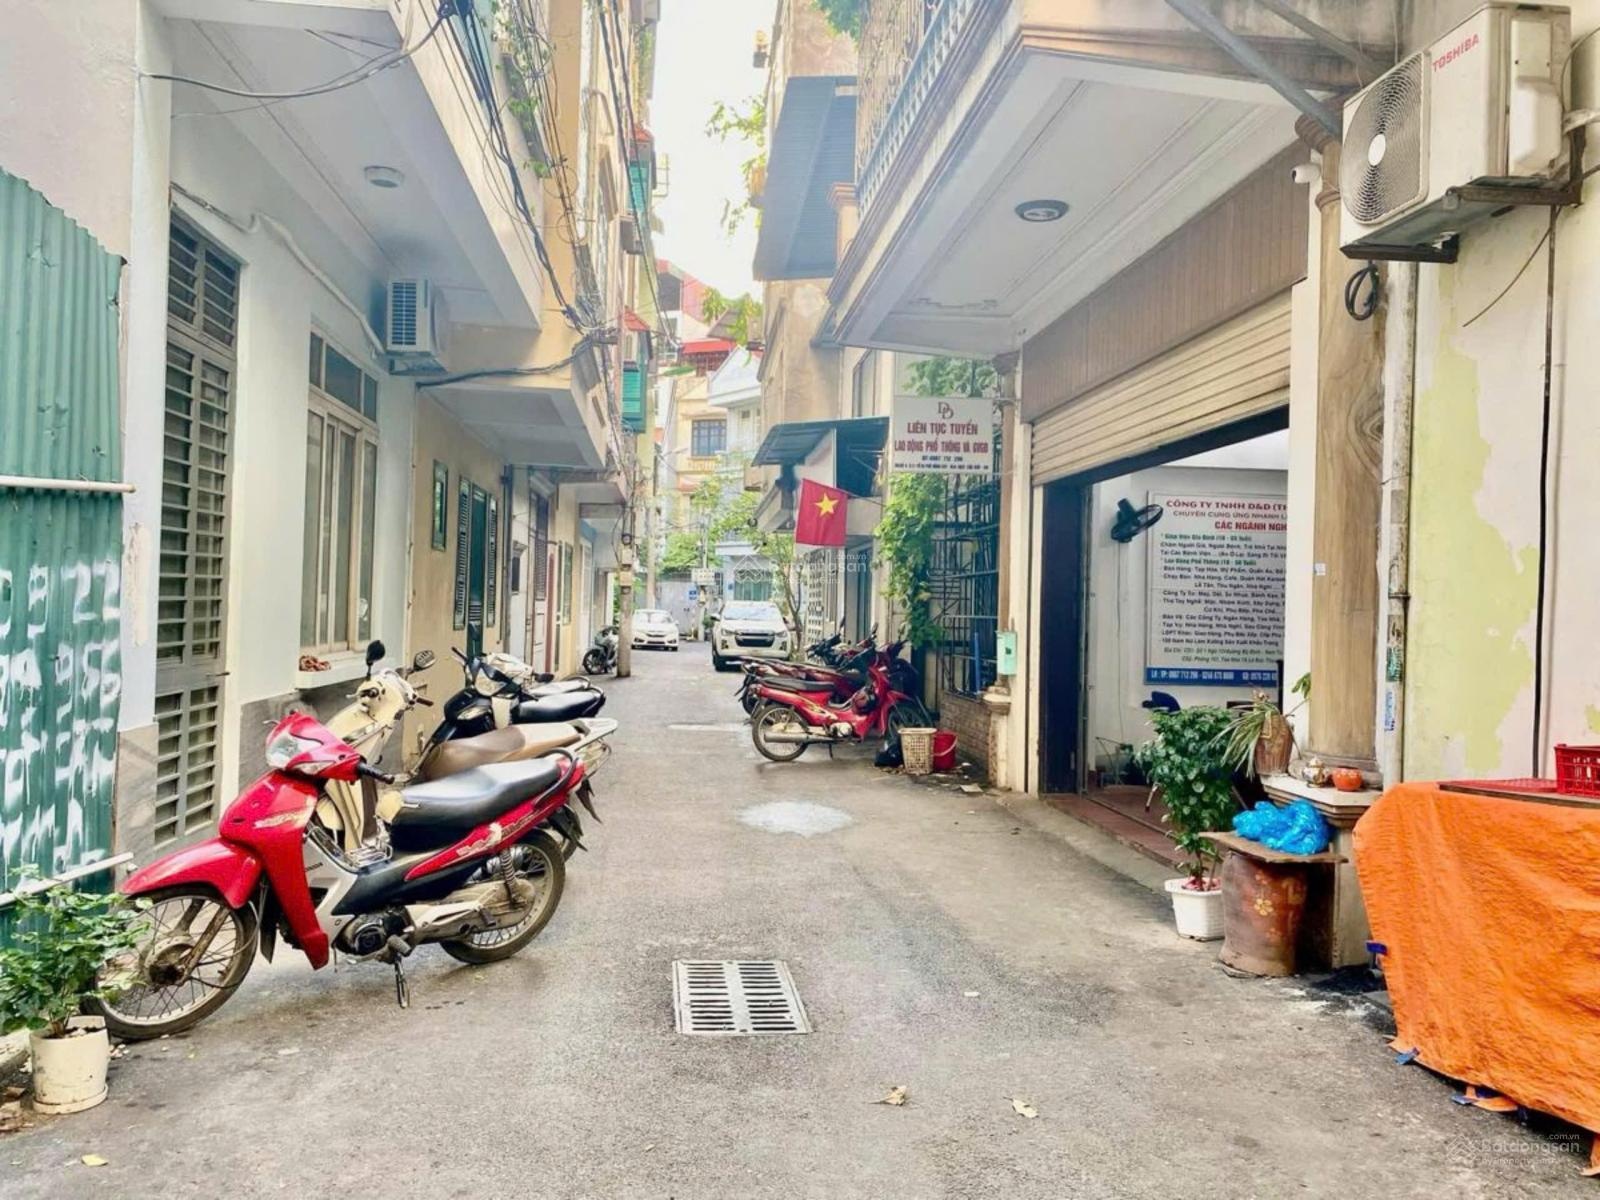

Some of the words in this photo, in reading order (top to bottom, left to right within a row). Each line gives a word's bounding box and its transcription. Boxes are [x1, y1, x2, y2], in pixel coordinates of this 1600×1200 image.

[1432, 34, 1479, 72] TOSHIBA
[907, 420, 927, 434] LIÊN
[930, 422, 947, 436] TỤC
[895, 440, 905, 451] LAO
[1166, 499, 1197, 508] CÔNG
[1215, 502, 1245, 510] TNHH
[1248, 503, 1271, 511] D&D
[1173, 510, 1205, 518] CHUYÊN
[1214, 519, 1233, 530] CÁC
[1235, 520, 1266, 531] NGÀNH
